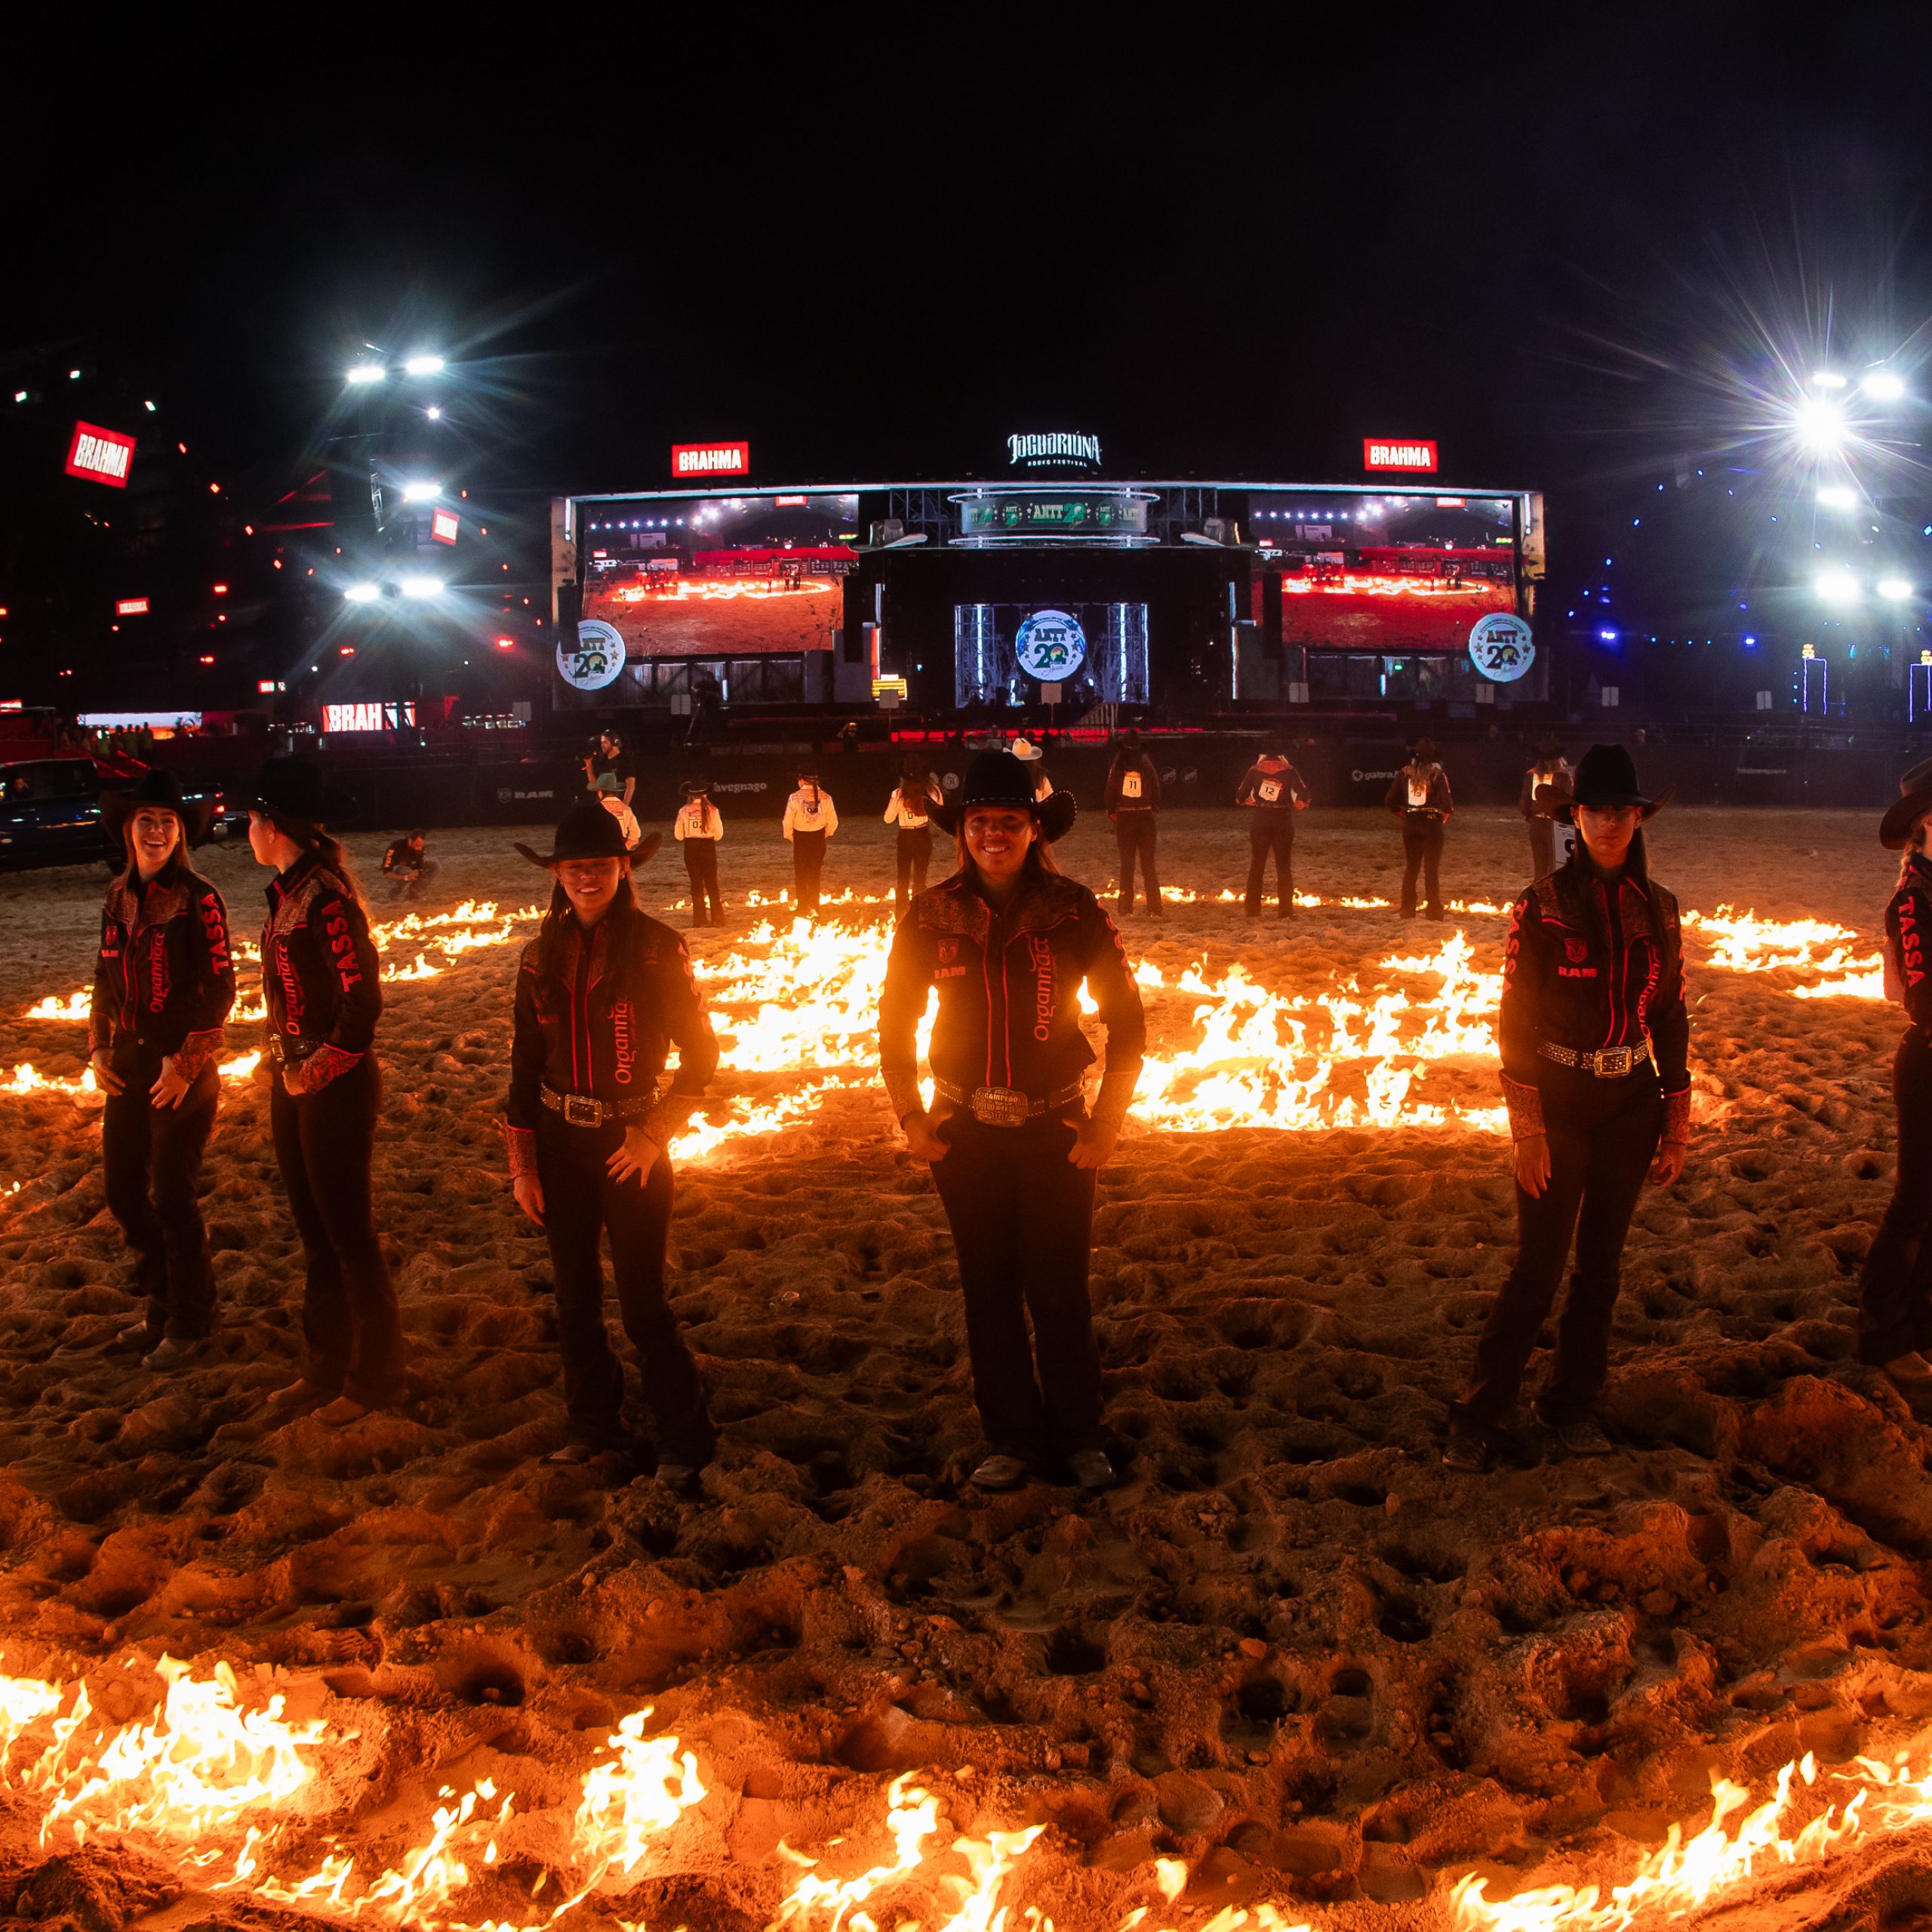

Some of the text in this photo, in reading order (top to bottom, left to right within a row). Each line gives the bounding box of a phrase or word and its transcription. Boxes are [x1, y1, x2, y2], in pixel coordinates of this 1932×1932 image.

[73, 432, 129, 478] BRAHMA
[678, 448, 742, 471] BRAHMA
[1053, 459, 1088, 467] FESTIVAL
[1370, 445, 1431, 467] BRAHMA
[1033, 642, 1069, 669] 20
[1486, 644, 1521, 669] 20
[514, 790, 554, 799] RAM
[713, 782, 768, 794] avegnago
[1129, 780, 1137, 790] 11
[1265, 786, 1275, 795] 12
[199, 892, 229, 976] TASSA
[1898, 894, 1927, 988] TASSA
[321, 898, 362, 994] TASSA
[1558, 966, 1598, 978] RAM
